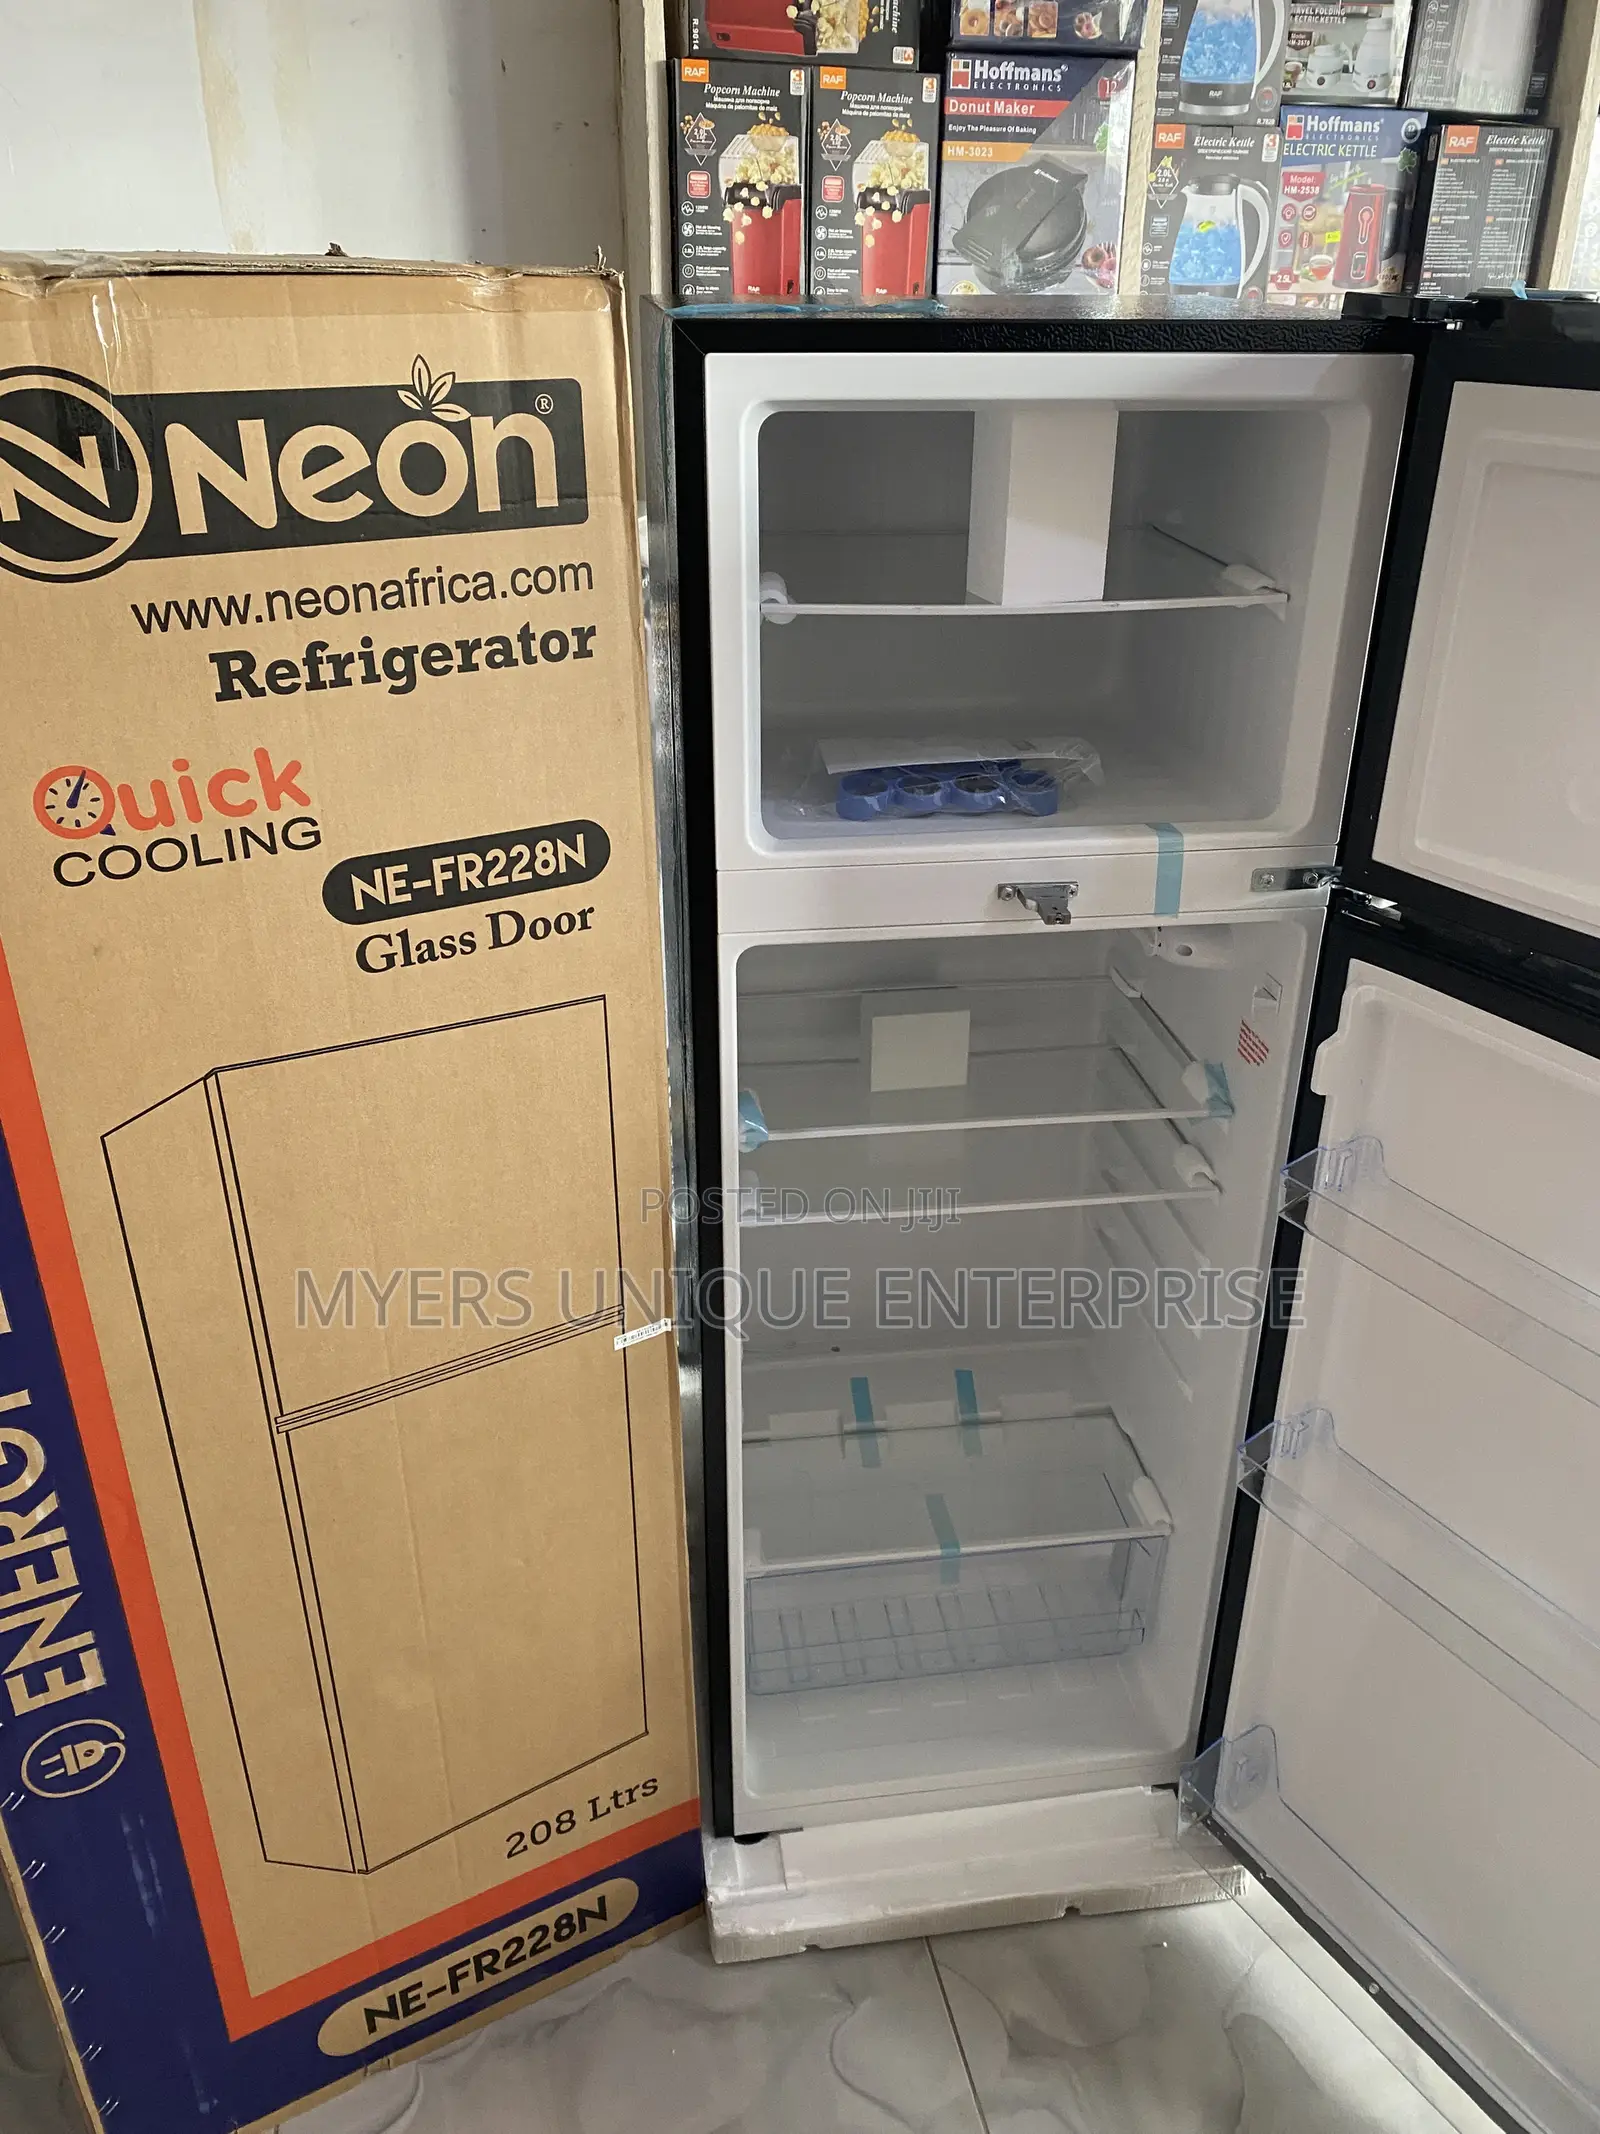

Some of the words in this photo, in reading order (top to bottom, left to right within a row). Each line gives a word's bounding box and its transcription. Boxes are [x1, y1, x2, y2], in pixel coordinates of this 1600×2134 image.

[891, 0, 901, 34] achine
[1315, 7, 1346, 16] FOLDING
[1320, 15, 1347, 24] KETTLE
[692, 18, 700, 50] R.9014
[684, 66, 706, 77] RAF
[974, 59, 1062, 82] Hoffmans
[823, 74, 844, 84] RAF
[704, 83, 741, 97] Popcorn
[742, 85, 781, 97] Machine
[974, 81, 1062, 92] ELECTRONICS
[1105, 80, 1118, 94] 12
[840, 90, 876, 104] Popcorn
[877, 92, 914, 105] Machine
[949, 99, 990, 113] Donut
[993, 100, 1036, 115] Maker
[948, 124, 966, 133] Enjoy
[967, 124, 979, 132] The
[1015, 126, 1037, 135] Baking
[1306, 114, 1381, 134] Hoffmans
[1158, 132, 1182, 143] RAF
[1193, 136, 1226, 147] Electric
[1228, 136, 1256, 148] Kettle
[1305, 134, 1380, 142] ELECTRONICS
[1448, 136, 1476, 148] RAF
[1485, 134, 1519, 145] Electric
[1520, 135, 1547, 145] Kettle
[947, 145, 993, 157] HM-3023
[1283, 143, 1336, 157] ELECTRIC
[1338, 144, 1378, 158] KETTLE
[1156, 168, 1173, 177] 2.0L
[1290, 175, 1316, 184] Model:
[1284, 185, 1320, 195] HM-2538
[164, 411, 559, 536] Neon
[131, 562, 594, 634] www.neonafrica.com
[208, 621, 598, 702] Refrigerator
[33, 747, 311, 840] Quick
[53, 816, 322, 887] COOLING
[350, 833, 587, 911] NE-FR228N
[356, 926, 477, 974] Glass
[486, 906, 595, 950] Door
[505, 1809, 576, 1859] 208
[586, 1777, 659, 1823] Ltrs
[363, 1895, 608, 2036] NE-FR228N
